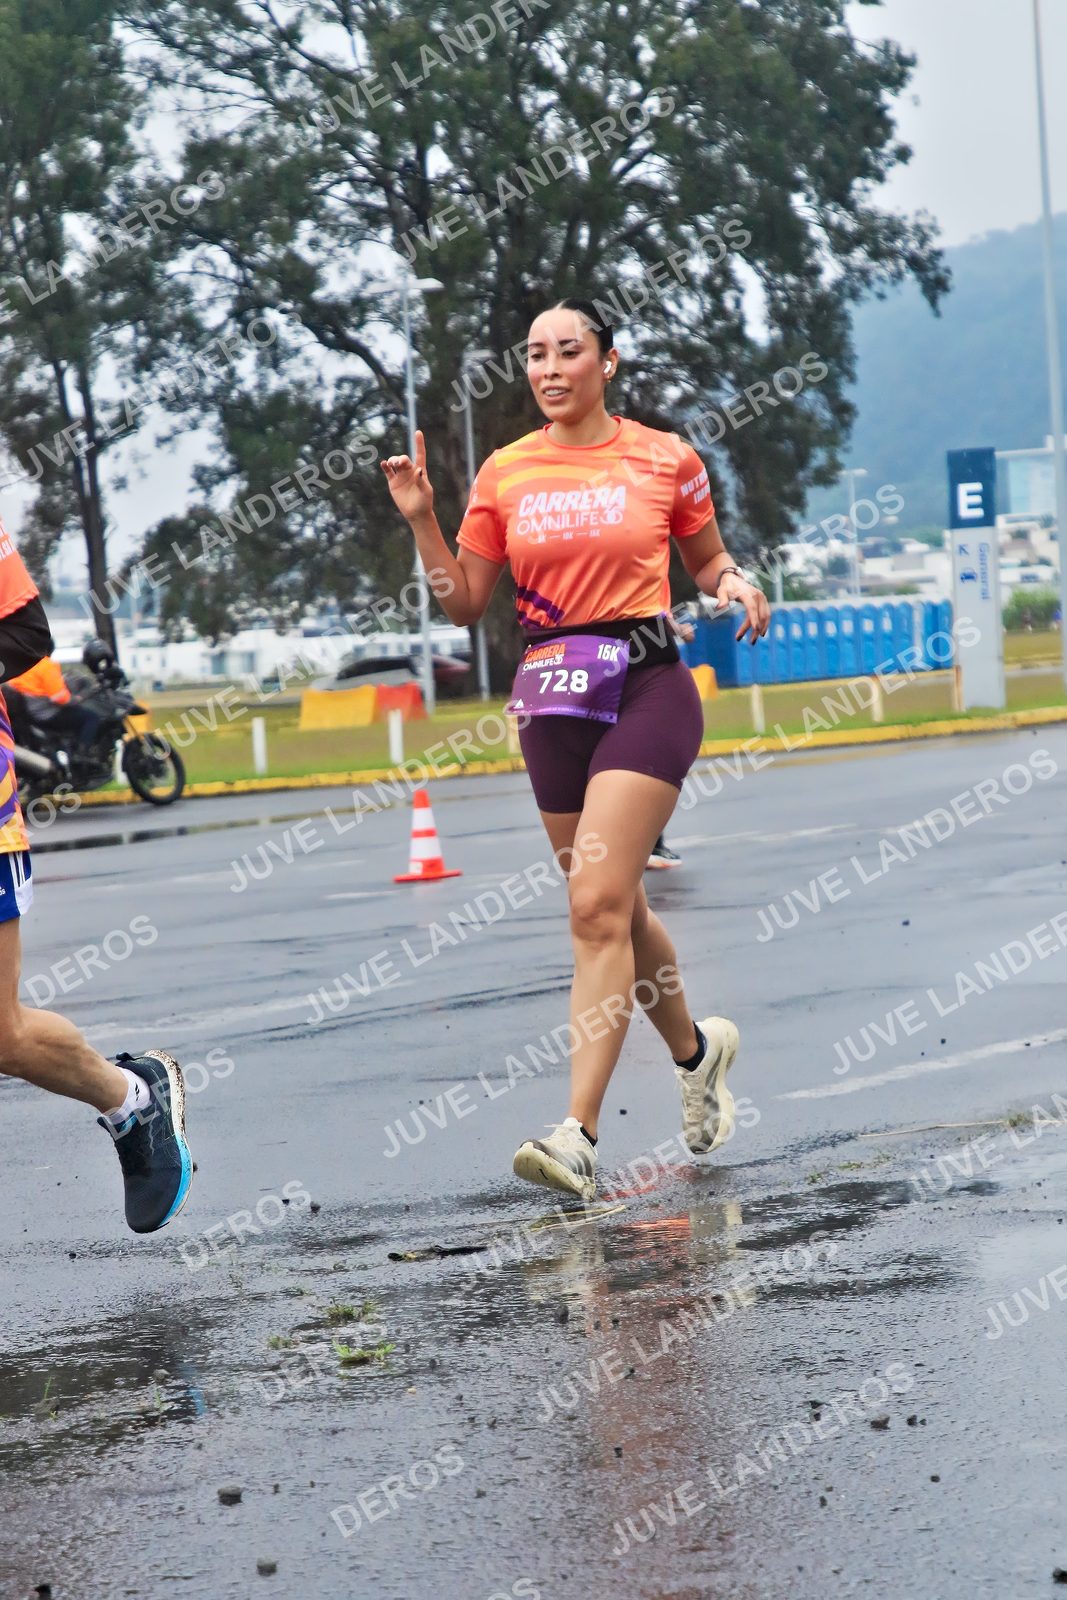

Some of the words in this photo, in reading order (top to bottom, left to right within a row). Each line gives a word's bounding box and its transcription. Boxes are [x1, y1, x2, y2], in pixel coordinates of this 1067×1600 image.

[519, 485, 626, 517] CARRERA
[957, 482, 985, 520] E
[516, 510, 600, 535] OMNILIFE
[524, 643, 566, 664] CARRERA
[539, 669, 589, 695] 728
